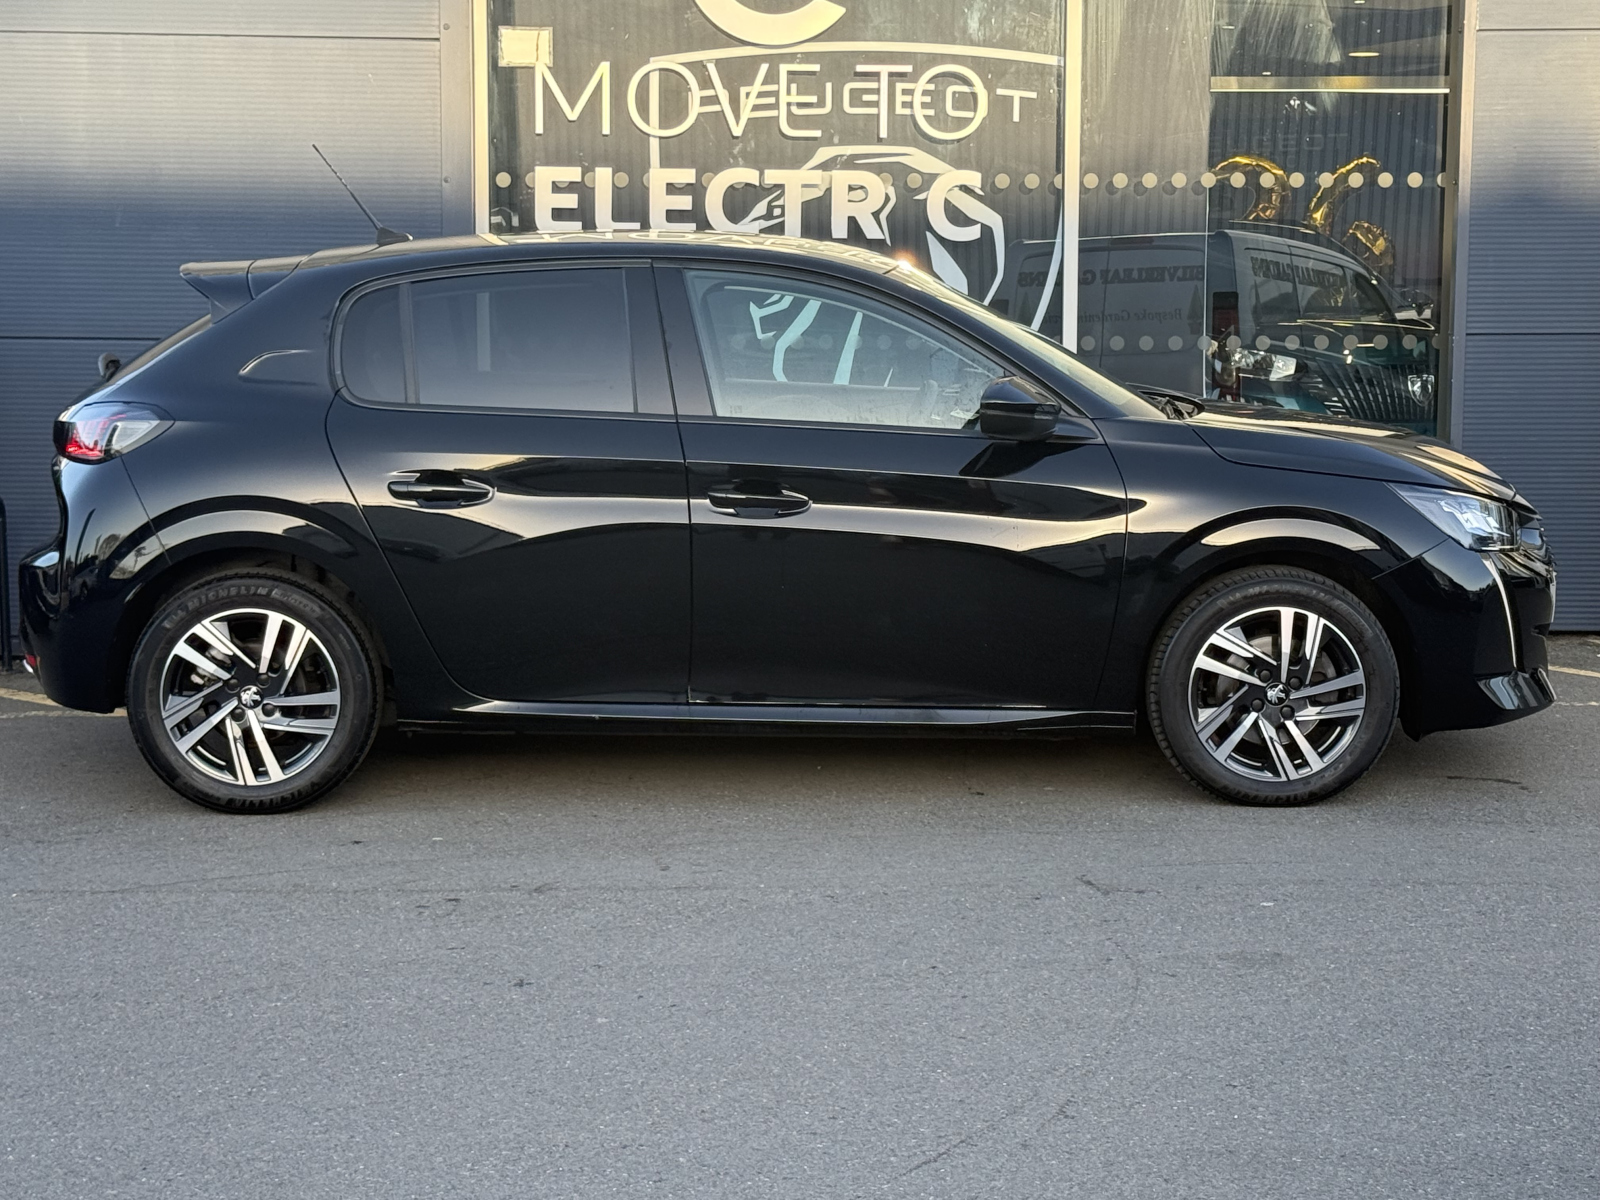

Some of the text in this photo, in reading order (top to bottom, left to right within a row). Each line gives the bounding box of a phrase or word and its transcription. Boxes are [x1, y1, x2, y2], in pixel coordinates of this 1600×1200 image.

[534, 61, 986, 141] MOVE TO
[188, 585, 269, 612] MICHELIN
